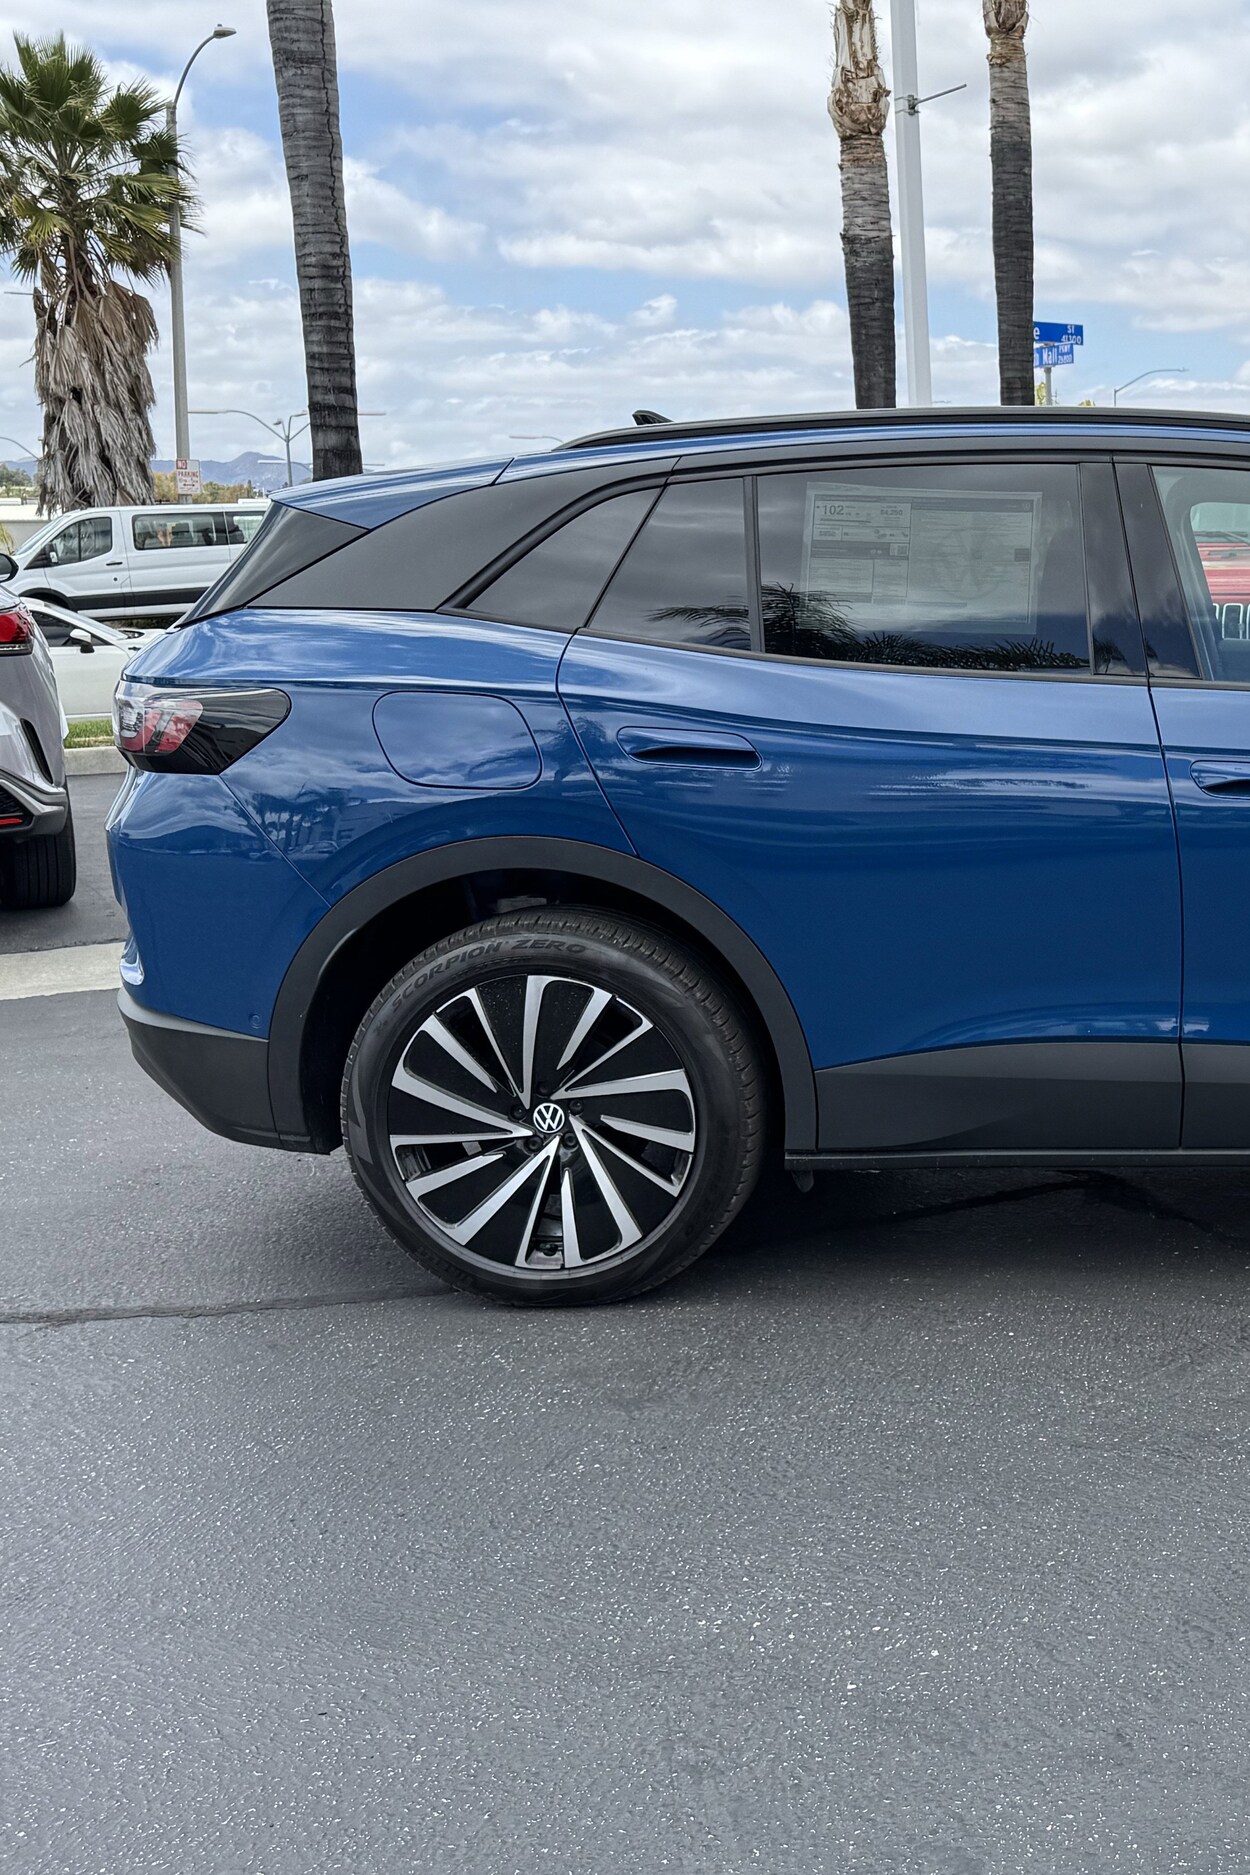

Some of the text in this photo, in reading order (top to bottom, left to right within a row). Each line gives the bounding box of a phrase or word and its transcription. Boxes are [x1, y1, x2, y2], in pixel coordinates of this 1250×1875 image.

[823, 505, 844, 516] 102
[391, 941, 502, 1014] SCORPION
[512, 938, 586, 954] ZERO
